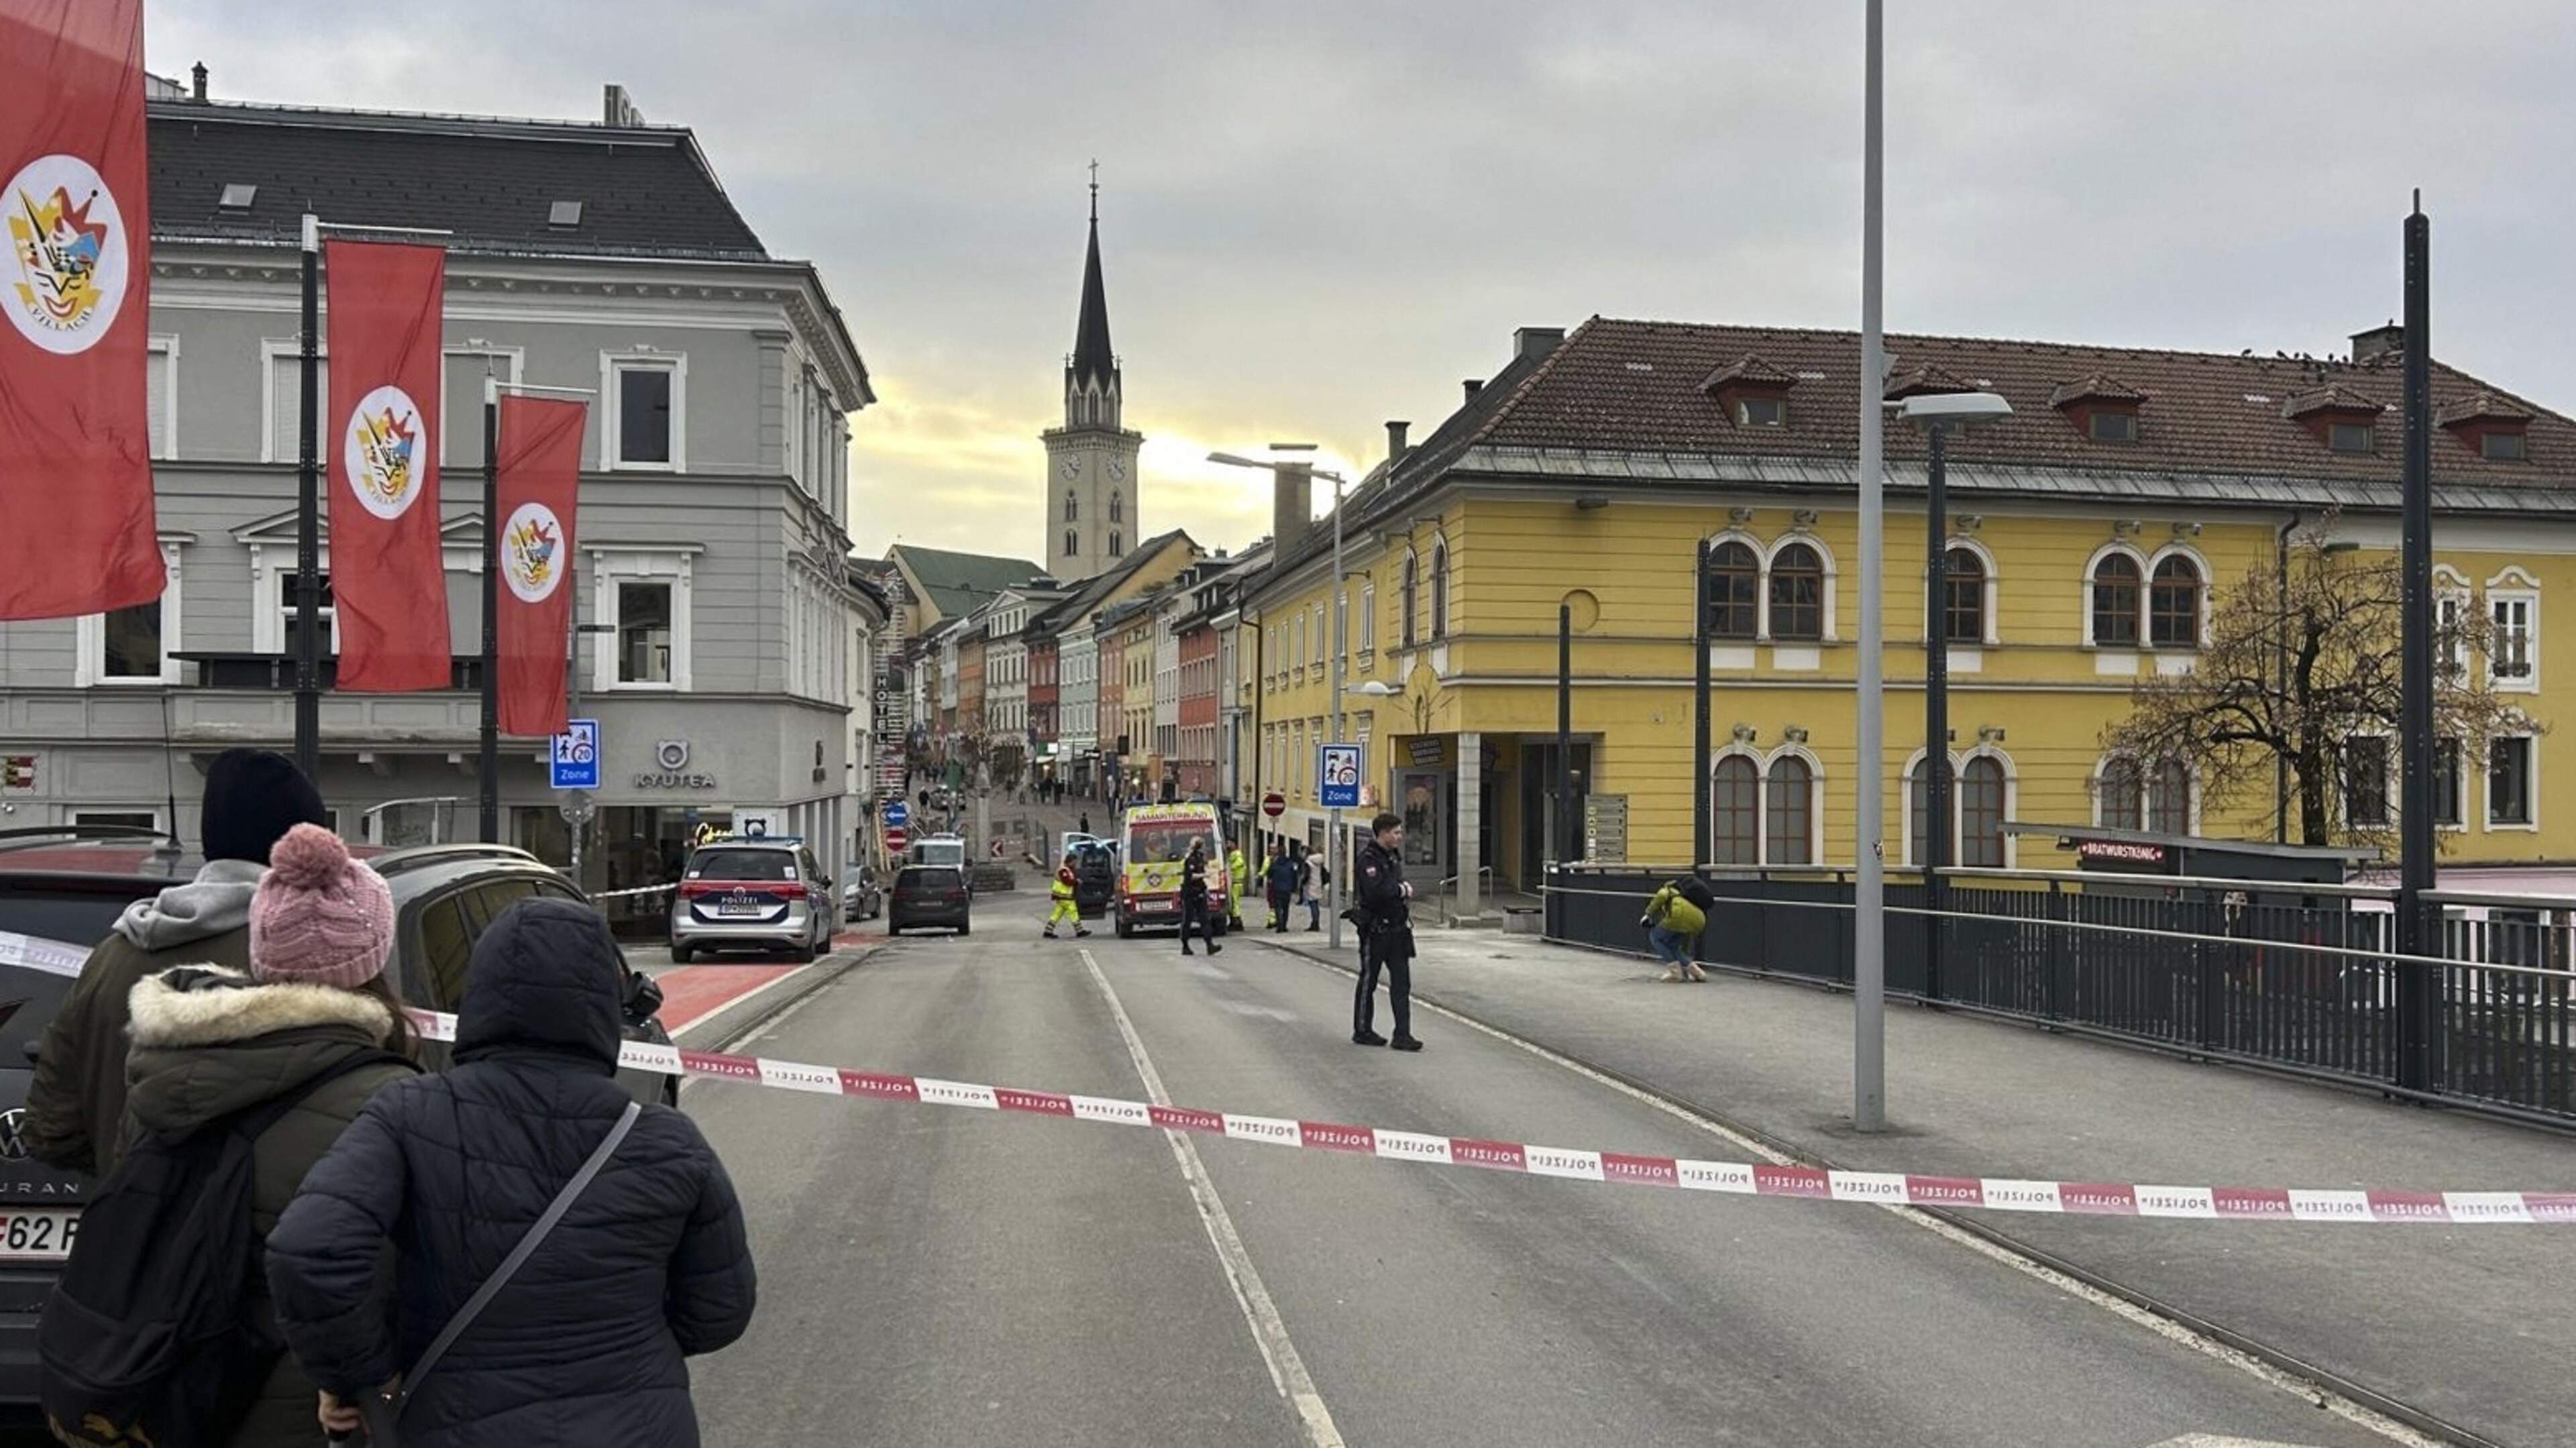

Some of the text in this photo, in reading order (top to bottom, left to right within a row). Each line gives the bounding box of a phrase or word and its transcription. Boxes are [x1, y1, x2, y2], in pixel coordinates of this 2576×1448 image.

[32, 308, 92, 331] VILLACH
[876, 677, 887, 744] HOTEL
[578, 748, 591, 761] 20
[559, 769, 590, 780] Zone
[634, 773, 715, 788] KYUTEA
[1342, 771, 1354, 783] 20
[1327, 790, 1353, 801] Zone
[8, 1216, 53, 1250] 62
